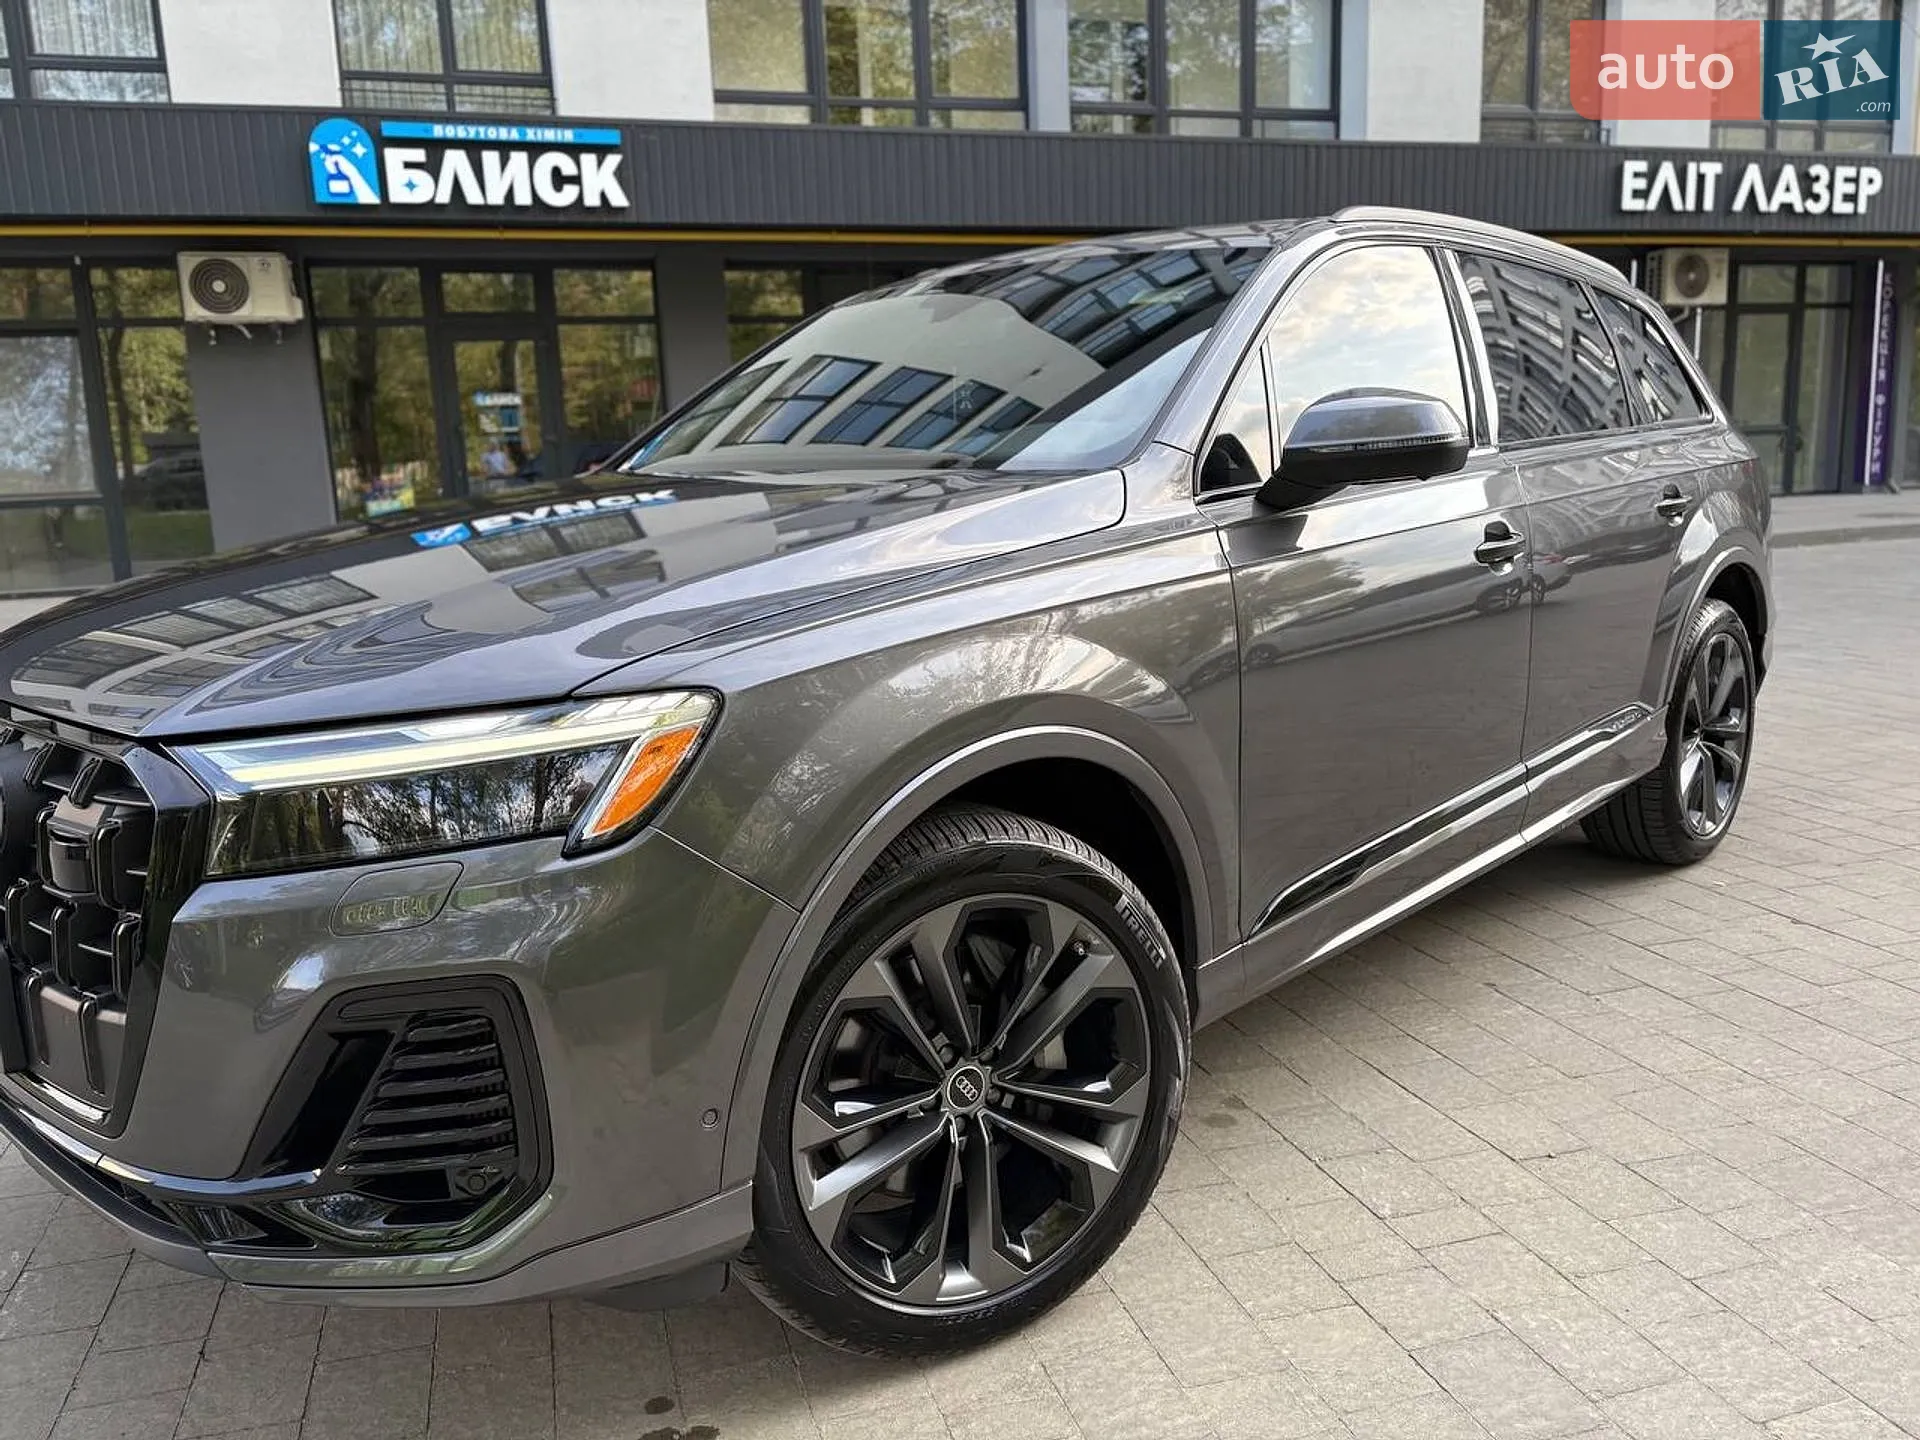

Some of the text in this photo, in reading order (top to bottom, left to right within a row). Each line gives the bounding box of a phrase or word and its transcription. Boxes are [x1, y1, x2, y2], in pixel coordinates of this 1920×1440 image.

[433, 124, 574, 142] ПОБУТОВА ХІМІЯ
[383, 147, 630, 208] БЛИСК
[1621, 160, 1884, 215] ЕЛІТ ЛАЗЕР
[1114, 894, 1167, 970] PIRELLI
